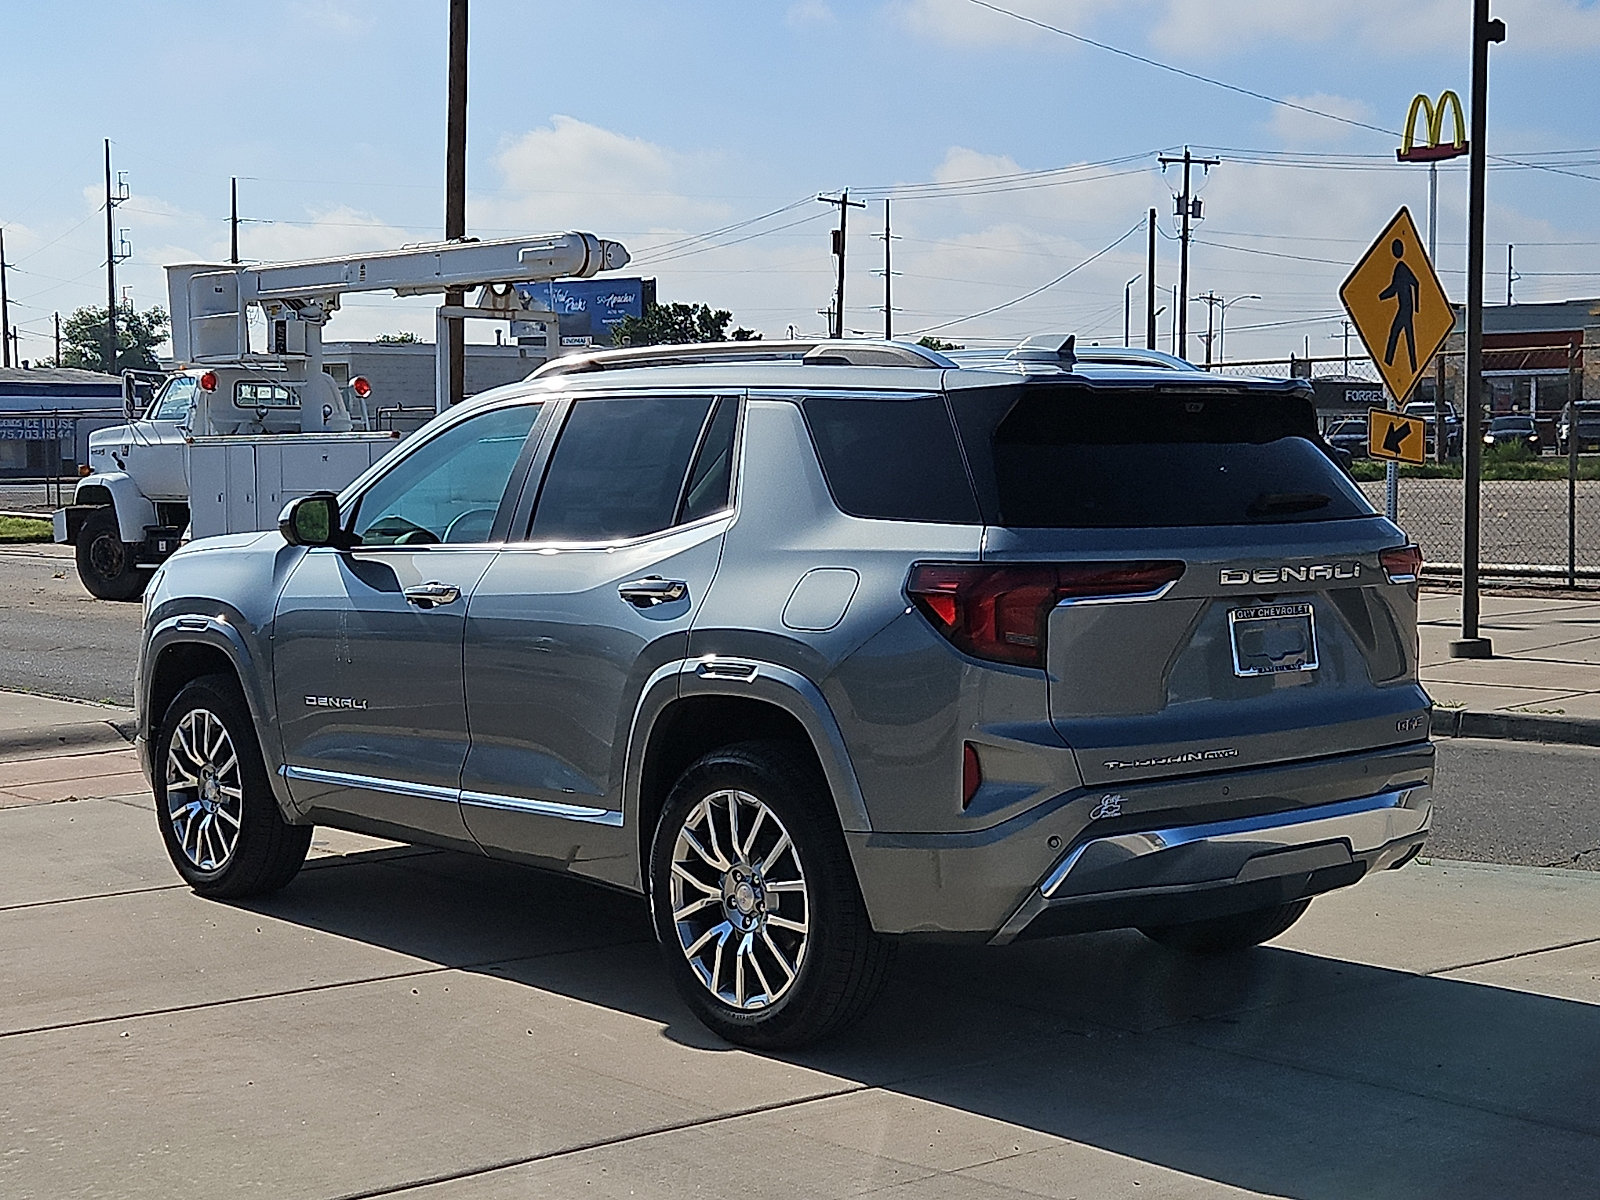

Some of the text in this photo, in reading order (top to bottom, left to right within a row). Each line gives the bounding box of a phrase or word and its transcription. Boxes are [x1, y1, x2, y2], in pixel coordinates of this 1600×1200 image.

[1220, 563, 1360, 585] DENALI
[1237, 605, 1308, 619] GUY CHEVROLET
[305, 696, 366, 709] DENALI
